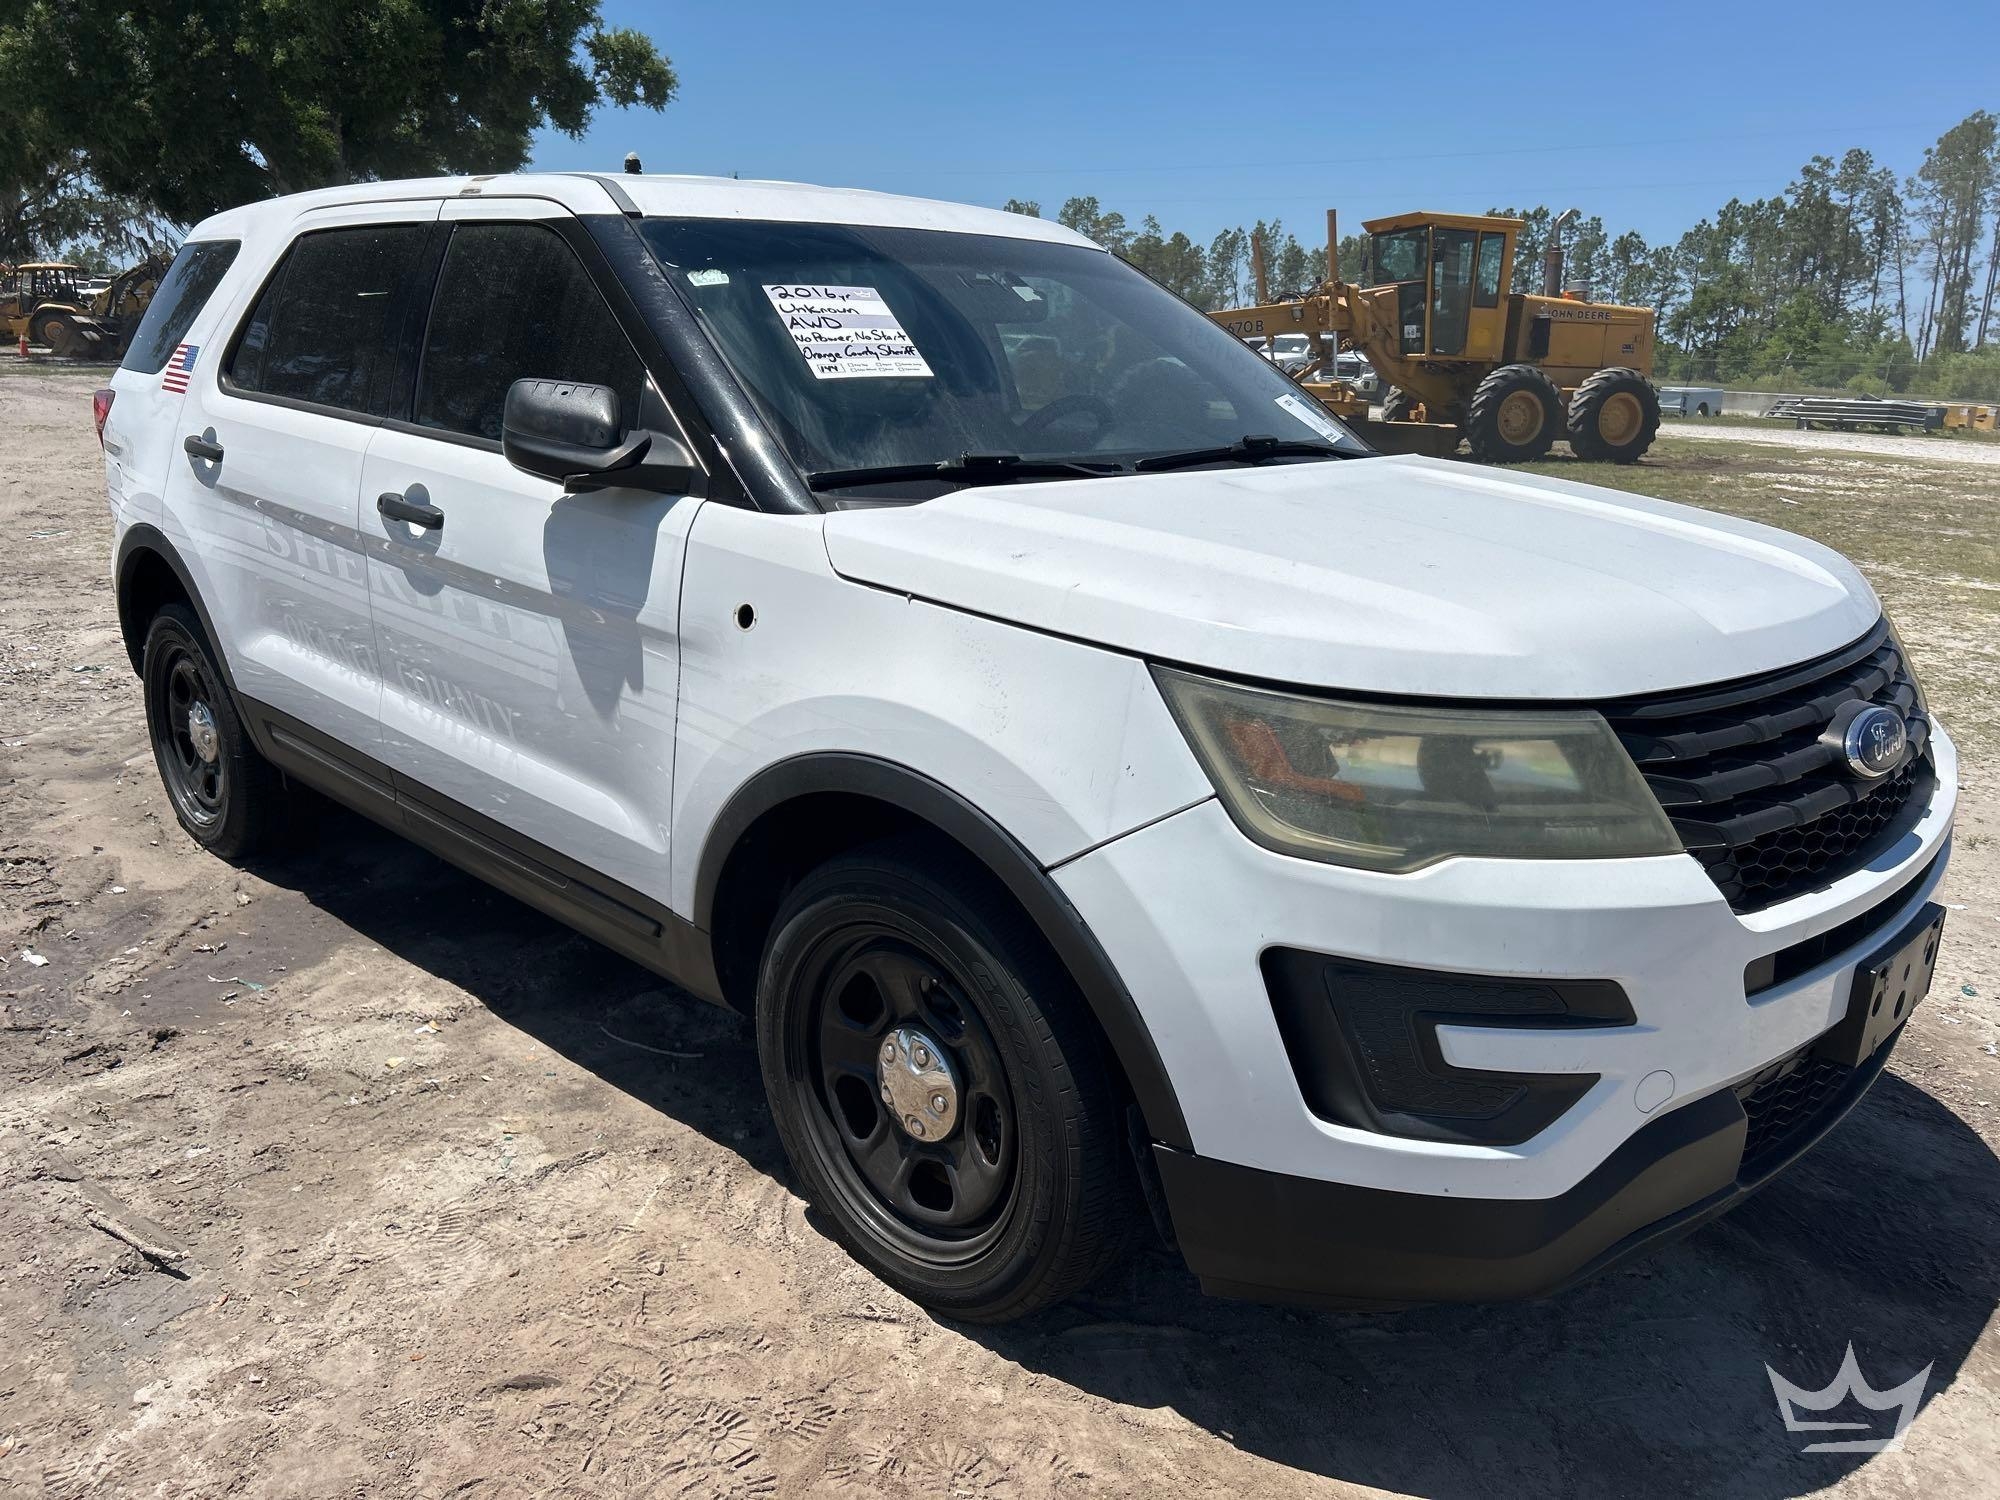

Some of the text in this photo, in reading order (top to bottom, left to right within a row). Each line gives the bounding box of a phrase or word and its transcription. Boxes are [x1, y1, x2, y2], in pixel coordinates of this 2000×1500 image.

[779, 303, 860, 315] Unknown
[1577, 311, 1611, 320] DEERE
[789, 316, 843, 330] AWD
[794, 334, 811, 343] No
[854, 331, 871, 341] No
[871, 329, 907, 341] Start
[802, 346, 842, 362] Orange
[844, 344, 880, 360] County
[821, 365, 839, 373] 144
[1871, 722, 1902, 762] Ford
